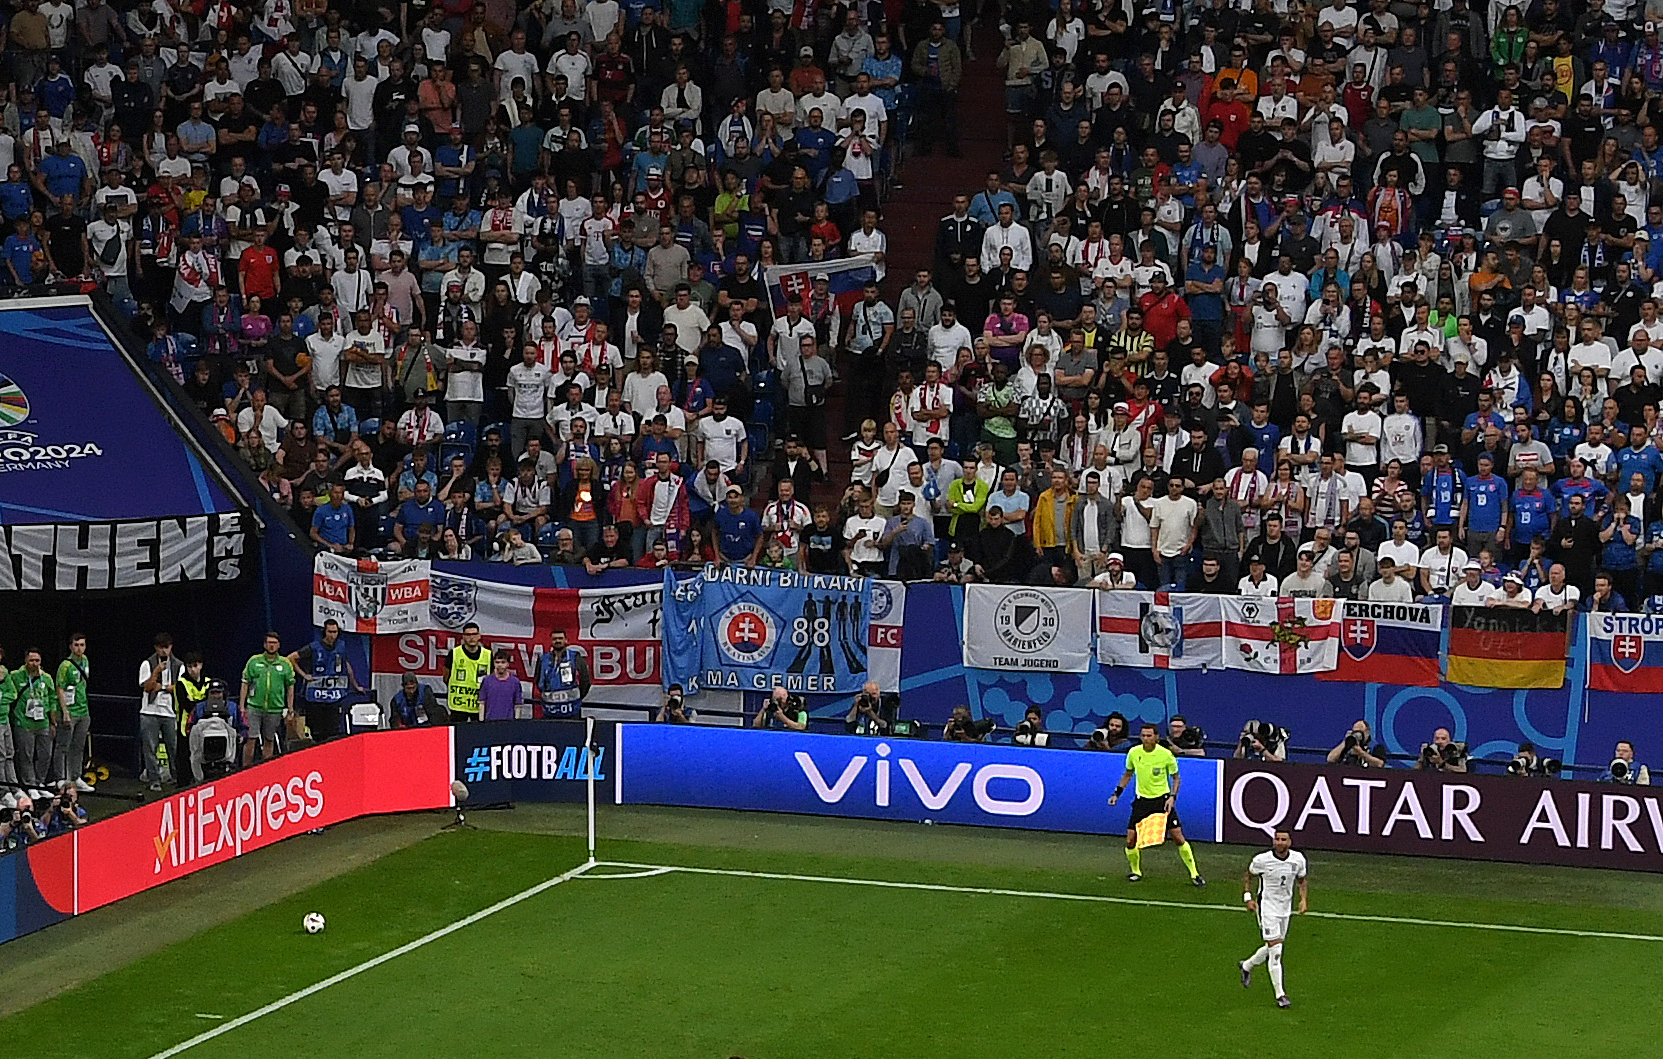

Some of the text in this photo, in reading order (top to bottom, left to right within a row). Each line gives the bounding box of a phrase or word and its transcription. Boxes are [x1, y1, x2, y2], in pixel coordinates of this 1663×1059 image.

[390, 585, 422, 600] WBA
[1042, 617, 1054, 627] 30
[792, 617, 830, 648] 88
[877, 627, 898, 645] FC
[993, 656, 1019, 667] TEAM
[753, 673, 836, 691] GEMER
[794, 742, 1045, 816] vivo
[1230, 771, 1485, 843] QATAR
[153, 771, 324, 874] AliExpress
